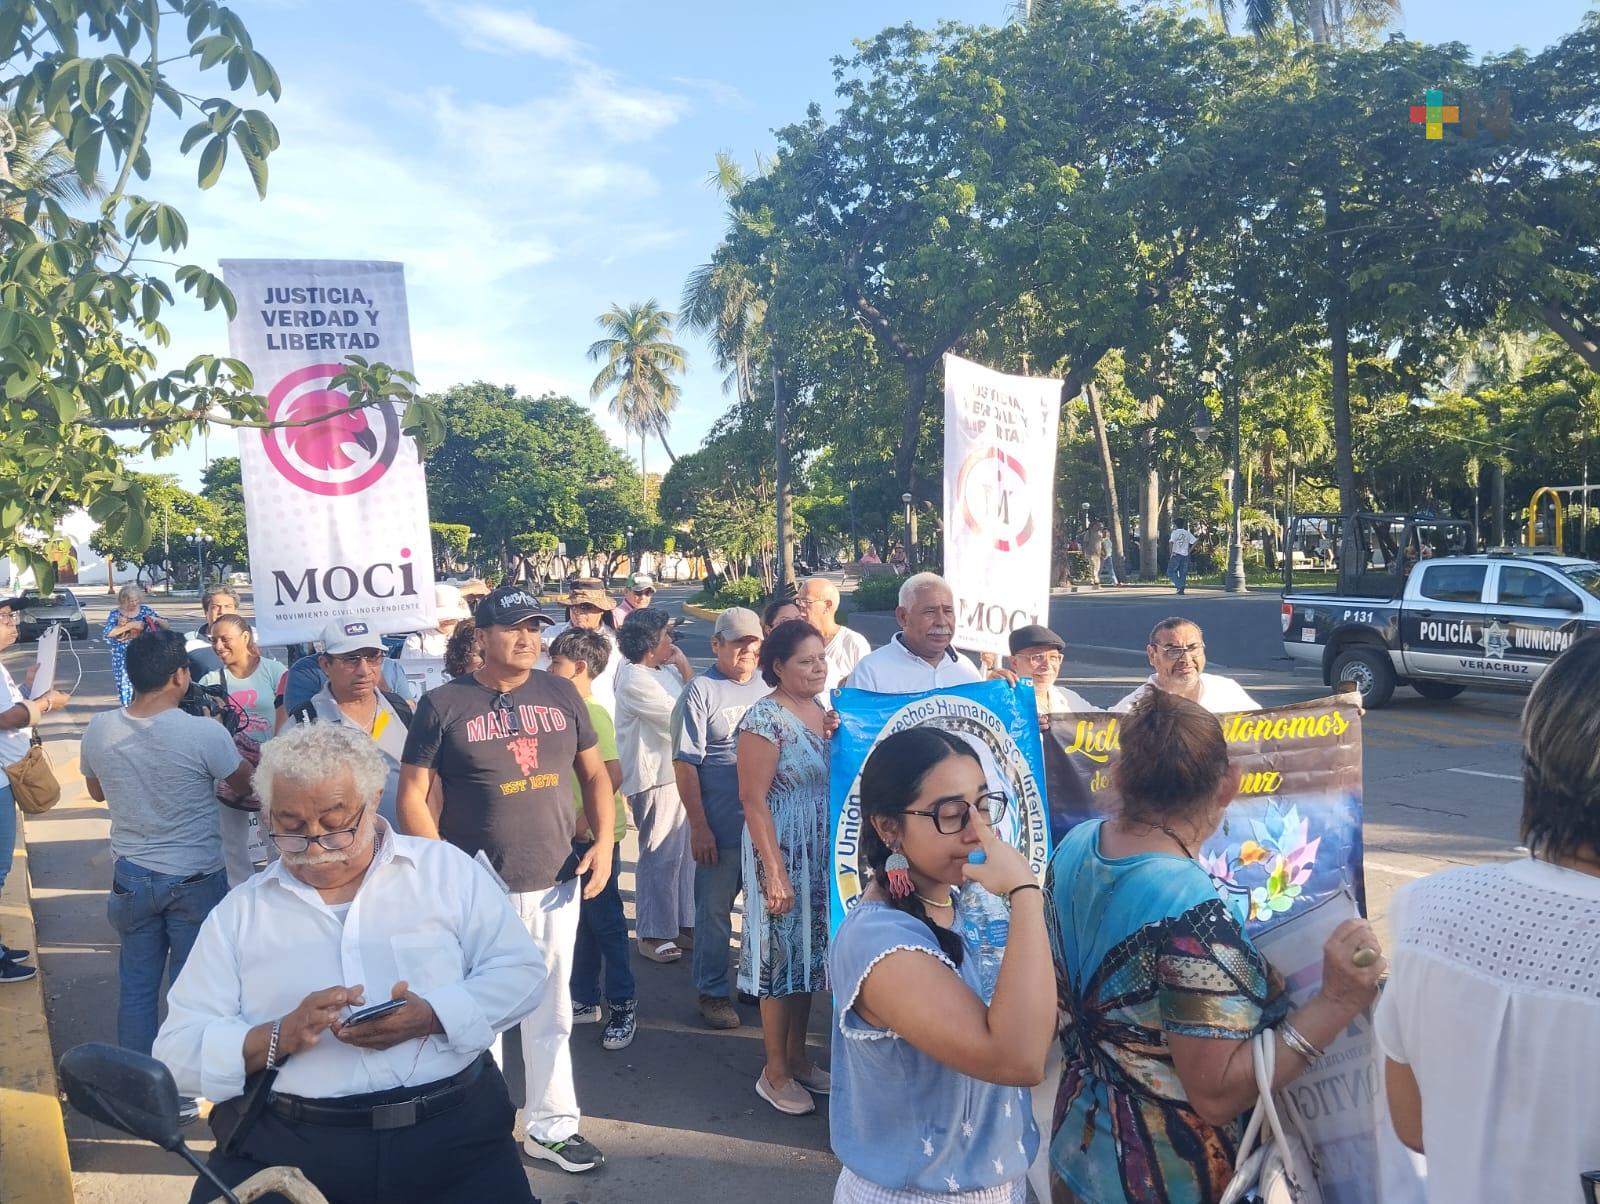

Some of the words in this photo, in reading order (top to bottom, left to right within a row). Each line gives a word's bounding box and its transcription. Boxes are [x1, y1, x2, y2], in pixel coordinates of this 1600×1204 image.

[264, 287, 374, 309] JUSTICIA,
[261, 309, 359, 327] VERDAD
[363, 309, 380, 327] Y
[267, 332, 380, 351] LIBERTAD
[275, 610, 329, 621] MOVIMIENTO
[332, 608, 353, 617] CIVIL
[357, 602, 420, 614] INDEPENDIENTE
[1343, 610, 1352, 621] P
[1354, 611, 1374, 624] 131
[1420, 619, 1473, 644] POLICÍA
[1459, 659, 1529, 674] VERACRUZ
[518, 705, 567, 735] UTD
[499, 779, 528, 796] EST
[889, 702, 935, 735] rechos
[935, 699, 1001, 733] Humanos
[1023, 772, 1047, 875] Internacio
[844, 793, 861, 857] Unión
